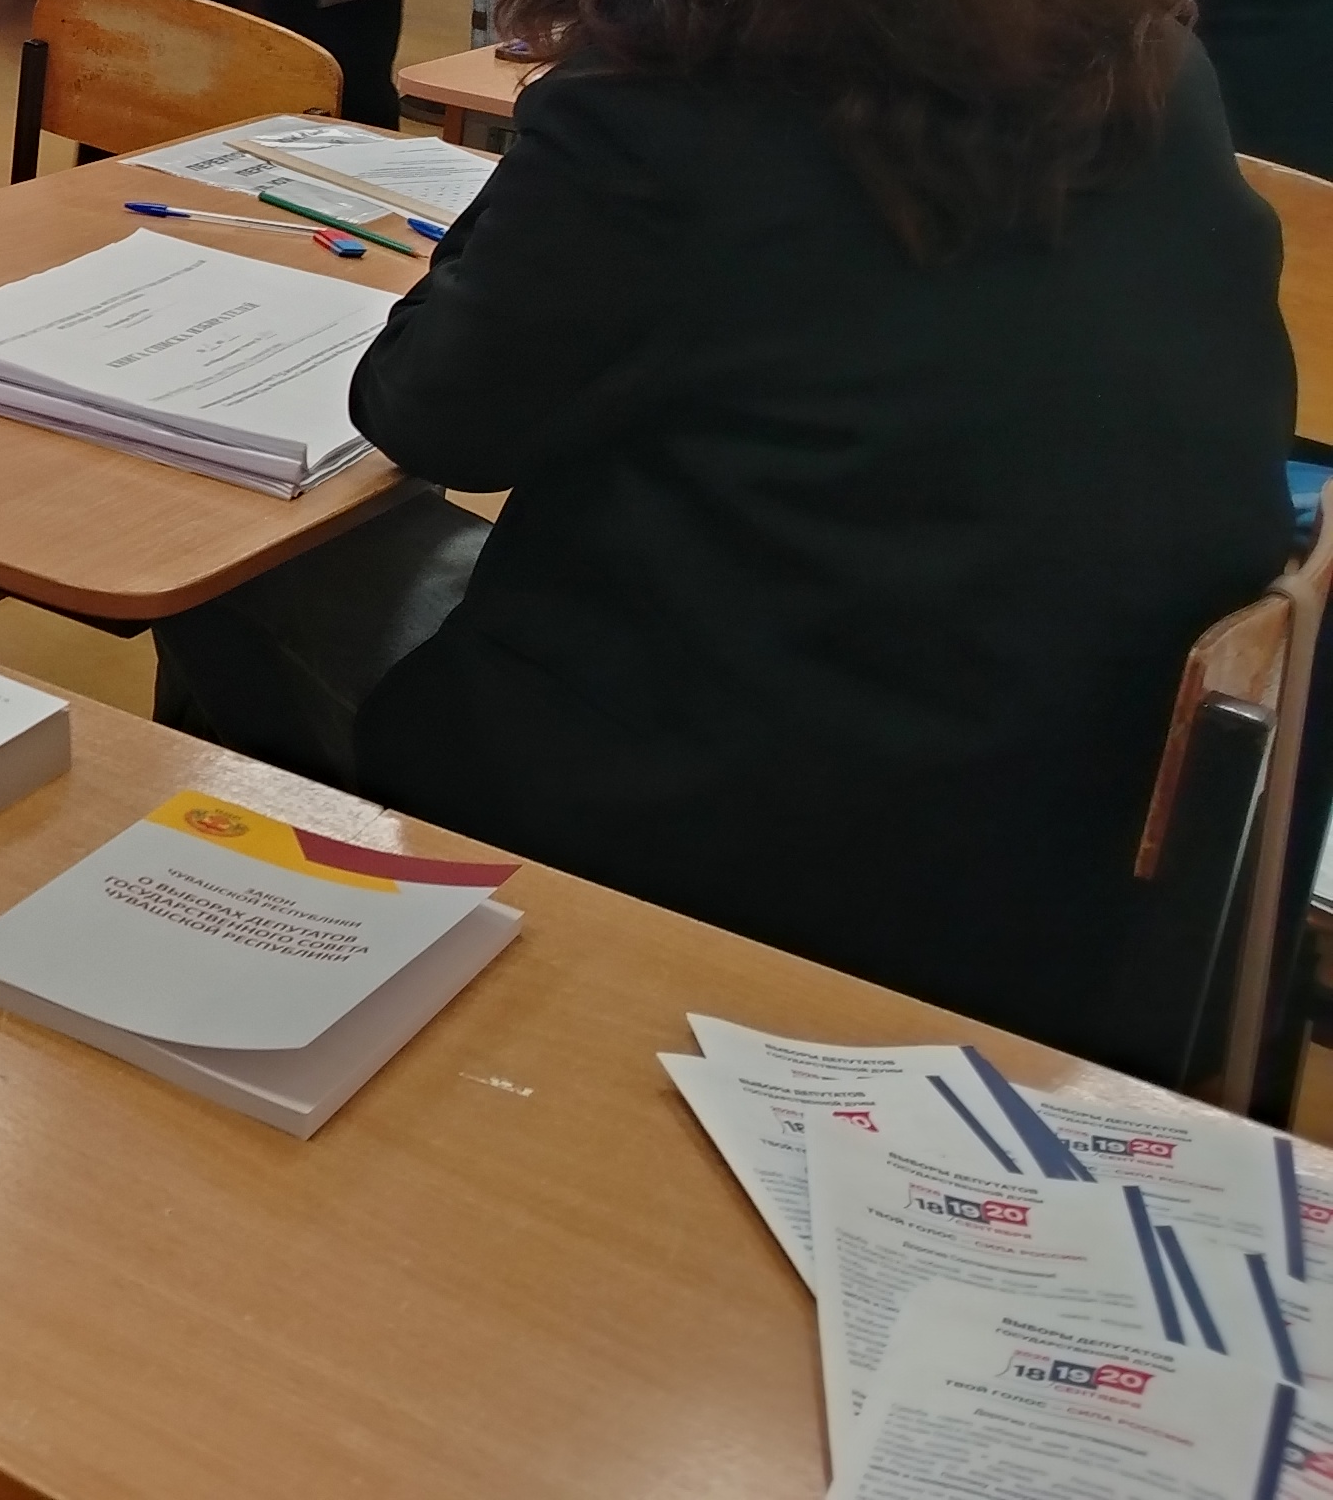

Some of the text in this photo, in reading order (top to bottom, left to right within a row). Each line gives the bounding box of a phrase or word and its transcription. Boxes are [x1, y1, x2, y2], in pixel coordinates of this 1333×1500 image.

[144, 333, 194, 353] СПИСКА
[185, 301, 261, 335] ИЗБИРАТЕЛЕЙ
[137, 876, 358, 943] О ВЫБОРАХ ДЕПУТАТОВ
[168, 867, 362, 929] ЧУВАШСКОЙ РЕСПУБЛИКИ
[244, 887, 297, 906] ЗАКОН
[104, 875, 369, 954] ГОСУДАРСТВЕННОГО СОВЕТА
[104, 887, 351, 963] ЧУВАШСКОЙ РЕСПУБЛИКИ
[1105, 1117, 1189, 1135] ДЕПУТАТОВ
[1095, 1139, 1126, 1153] 19
[1132, 1141, 1169, 1155] 20
[889, 1151, 1038, 1194] ВЫБОРЫ ДЕПУТАТОВ
[915, 1197, 1024, 1222] 18 19 20
[908, 1223, 958, 1241] ГОЛОС
[995, 1327, 1130, 1361] ГОСУДАРСТВЕННОЙ
[1002, 1317, 1175, 1363] ВЫБОРЫ ДЕПУТАТОВ
[1013, 1364, 1143, 1389] 18 19 20
[945, 1378, 988, 1394] ТВОЙ
[991, 1389, 1048, 1409] ГОЛОС
[1054, 1384, 1142, 1409] СЕНТЯБРЯ
